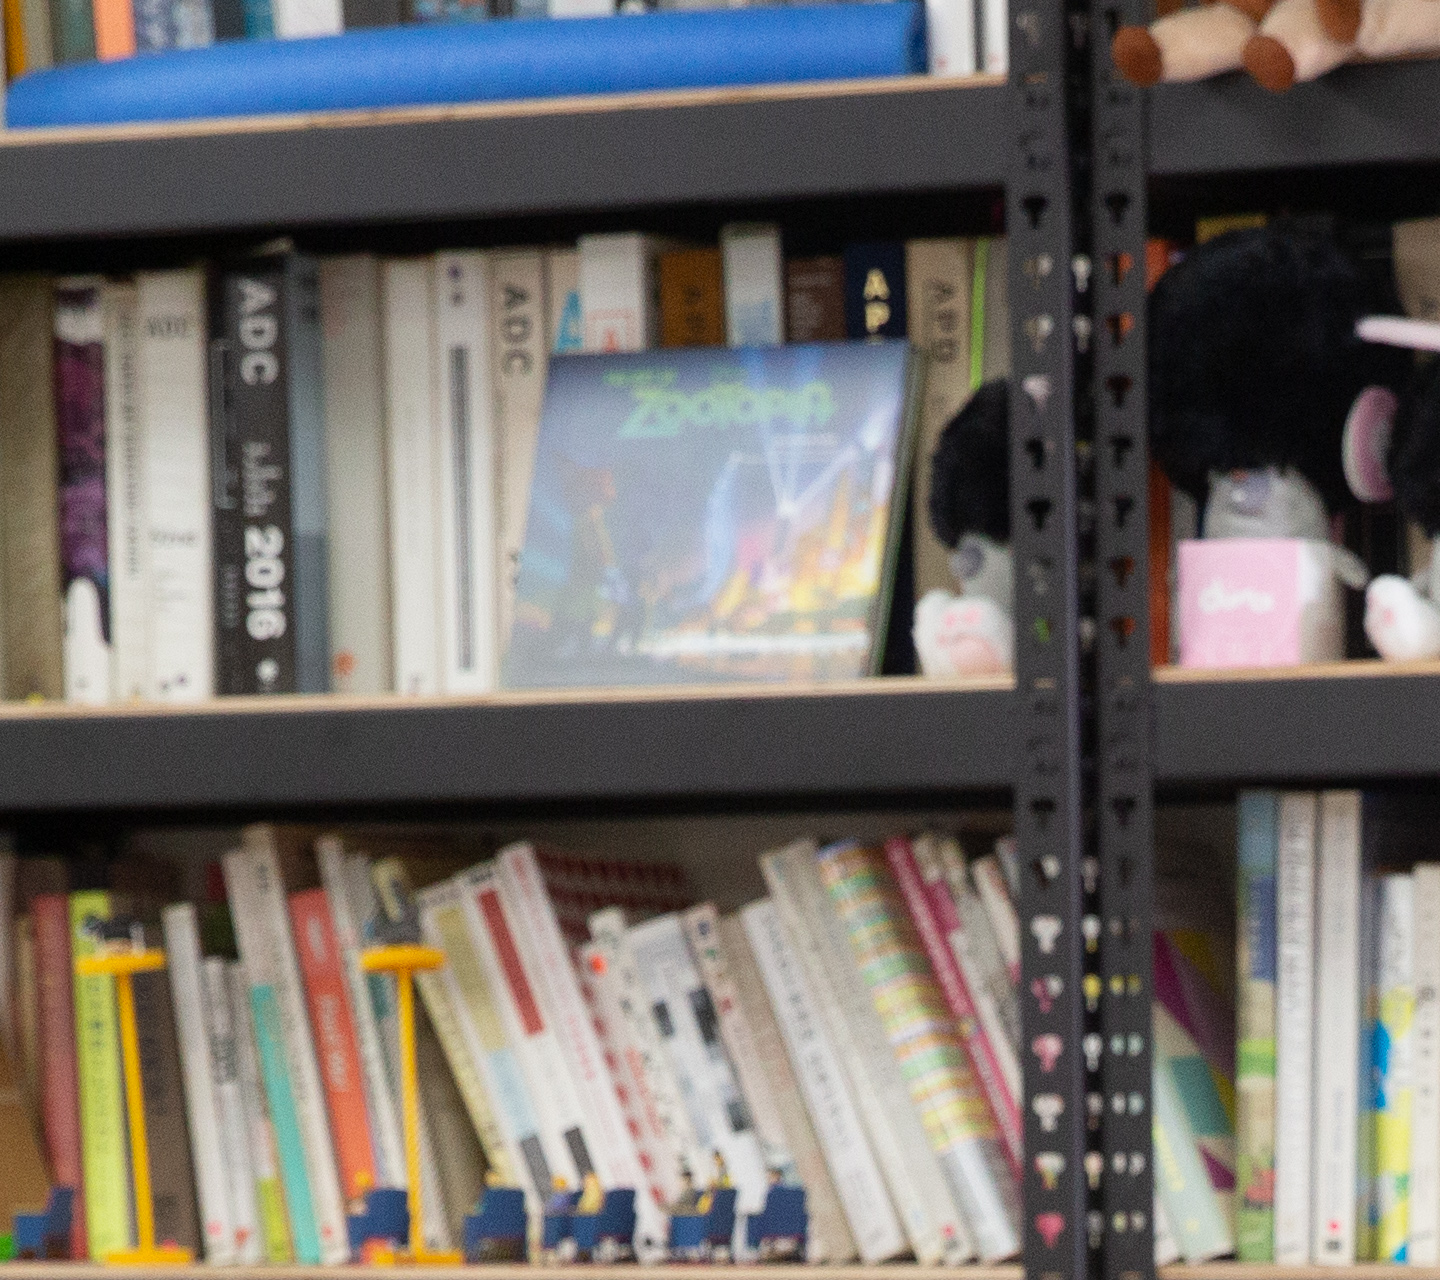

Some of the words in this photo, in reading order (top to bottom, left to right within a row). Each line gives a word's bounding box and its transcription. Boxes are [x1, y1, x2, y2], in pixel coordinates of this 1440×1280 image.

[234, 276, 277, 386] ADC
[498, 280, 533, 378] ADC
[243, 523, 287, 641] 2016
